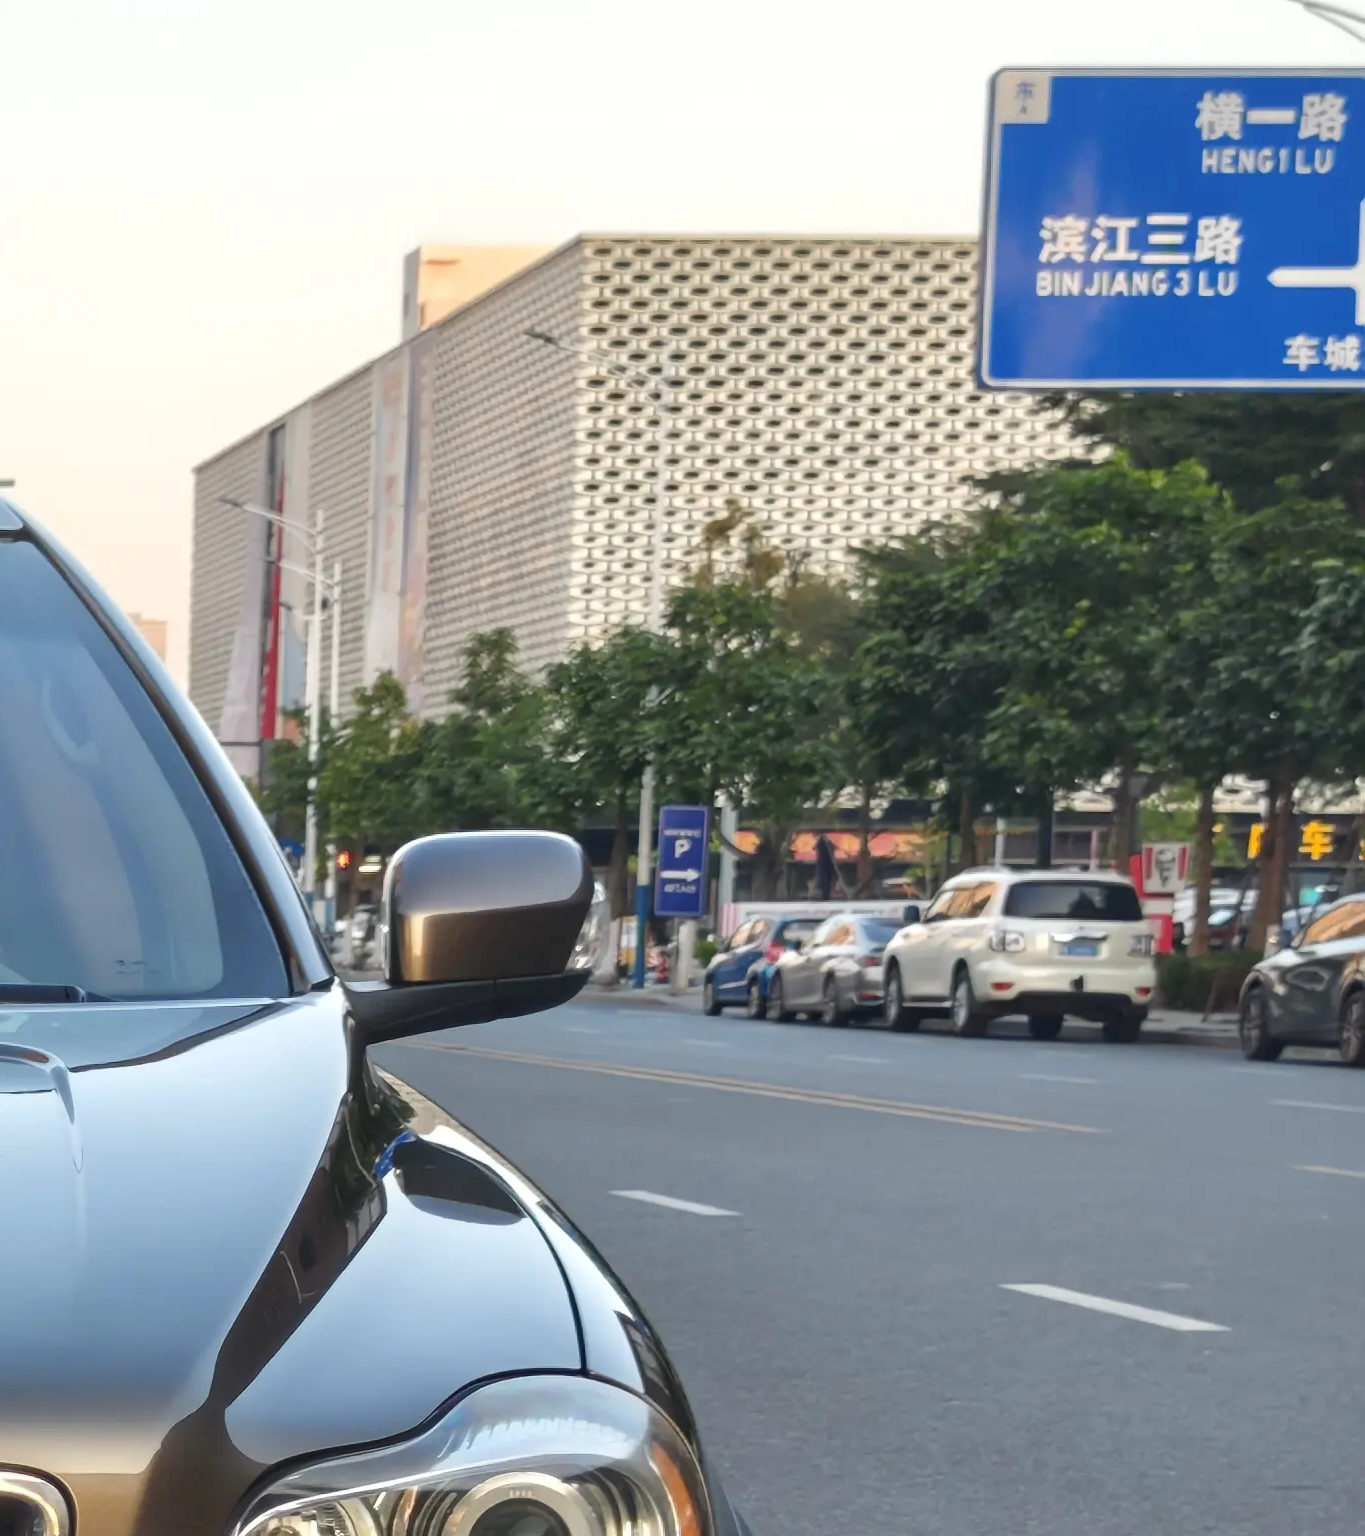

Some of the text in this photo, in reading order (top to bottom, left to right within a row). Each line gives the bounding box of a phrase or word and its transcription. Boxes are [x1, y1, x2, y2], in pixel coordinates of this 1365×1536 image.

[1194, 90, 1347, 142] 横一路
[1038, 212, 1244, 266] 滨江三路
[1282, 334, 1362, 372] 车城
